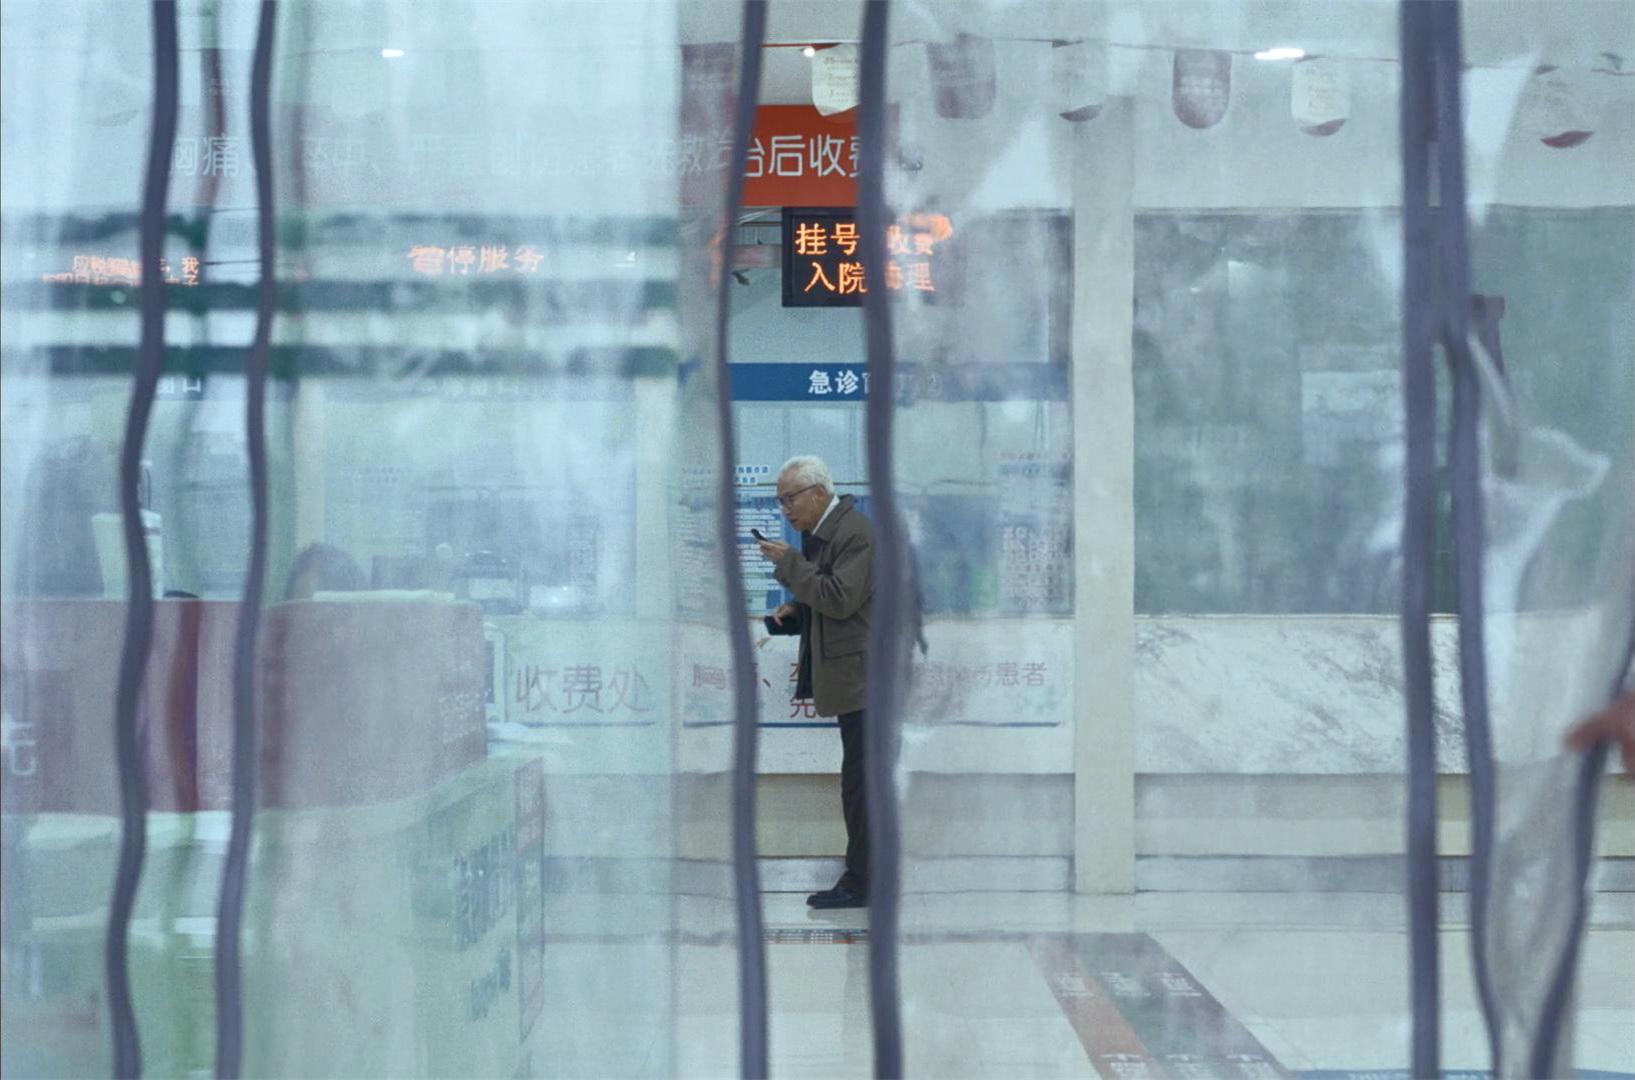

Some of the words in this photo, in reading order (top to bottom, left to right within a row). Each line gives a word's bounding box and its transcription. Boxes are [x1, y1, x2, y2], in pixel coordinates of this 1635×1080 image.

[795, 223, 860, 255] 挂号
[516, 664, 656, 714] 收费处
